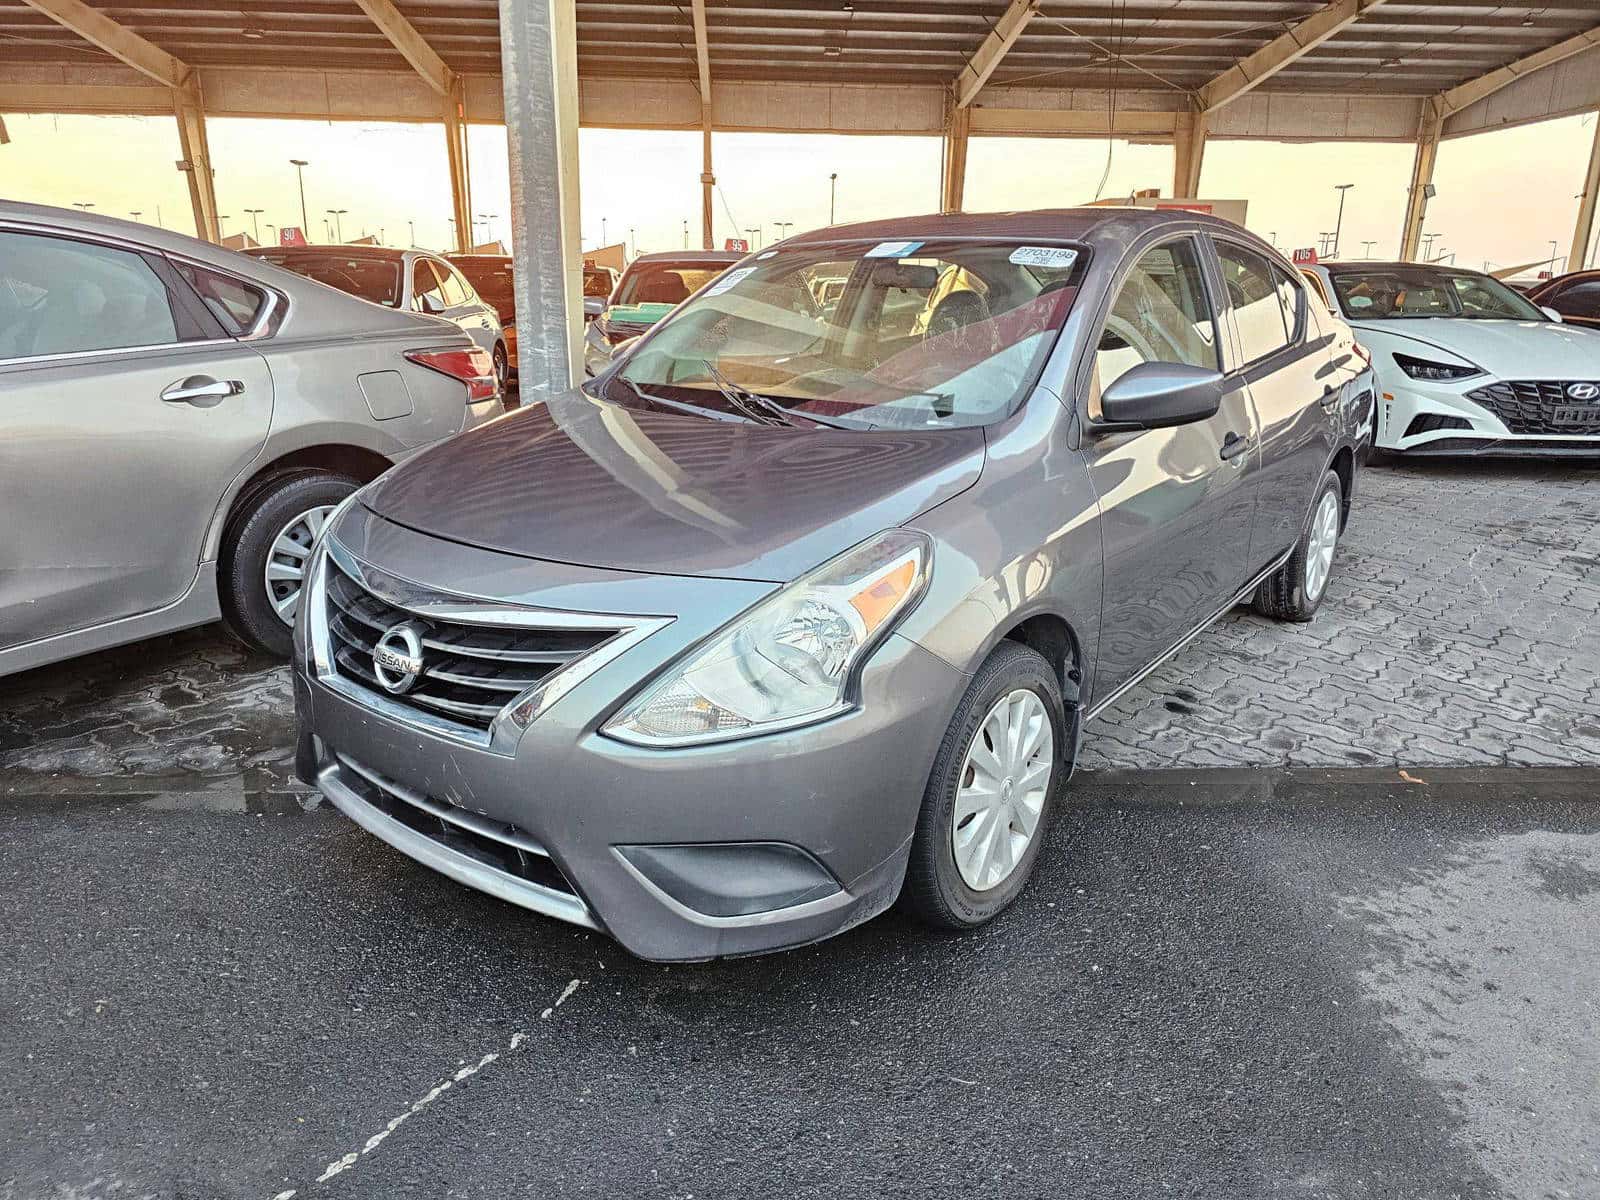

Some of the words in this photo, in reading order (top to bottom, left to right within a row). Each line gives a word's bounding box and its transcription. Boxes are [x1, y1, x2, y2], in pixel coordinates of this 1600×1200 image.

[283, 229, 295, 240] 90
[731, 240, 743, 252] 95
[1295, 249, 1311, 260] 105
[375, 648, 411, 669] NISSAN
